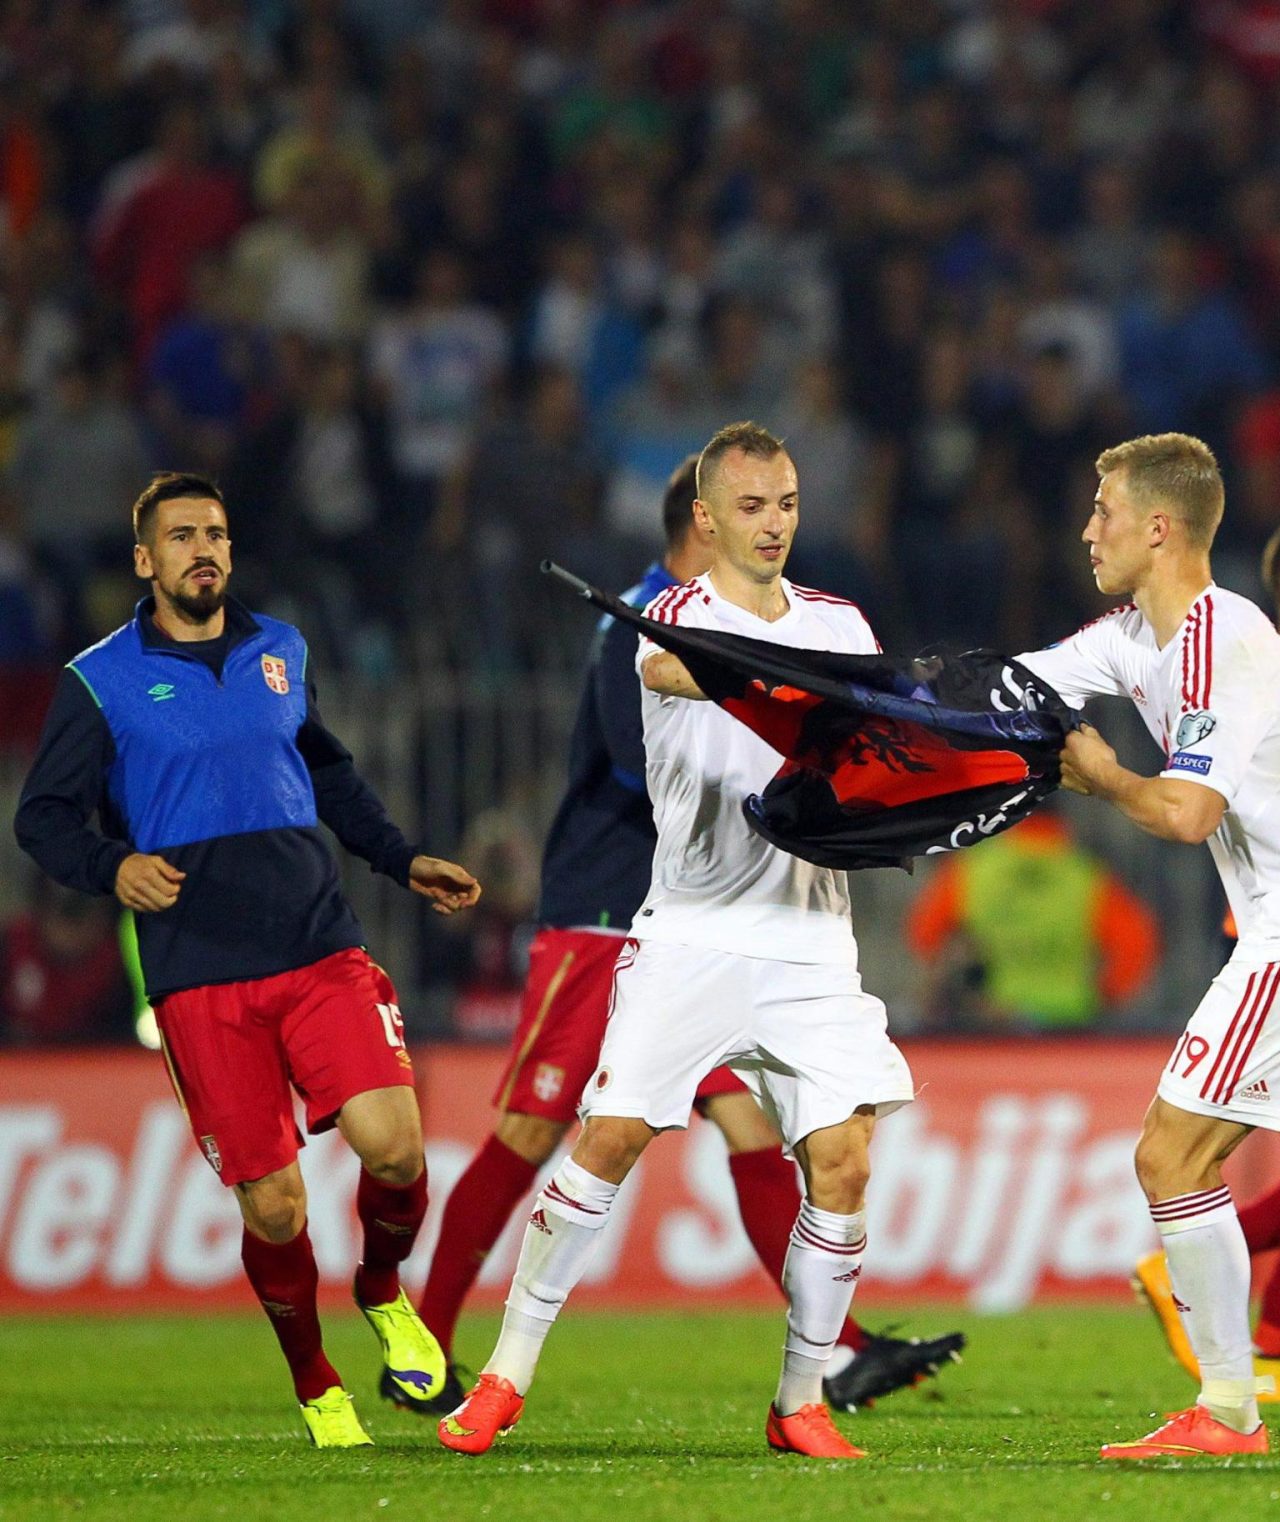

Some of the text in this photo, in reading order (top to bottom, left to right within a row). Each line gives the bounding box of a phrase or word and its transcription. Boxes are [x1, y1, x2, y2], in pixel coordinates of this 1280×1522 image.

[1170, 1031, 1210, 1079] 19
[1240, 1091, 1271, 1101] adidas
[653, 1092, 1160, 1316] Sbija
